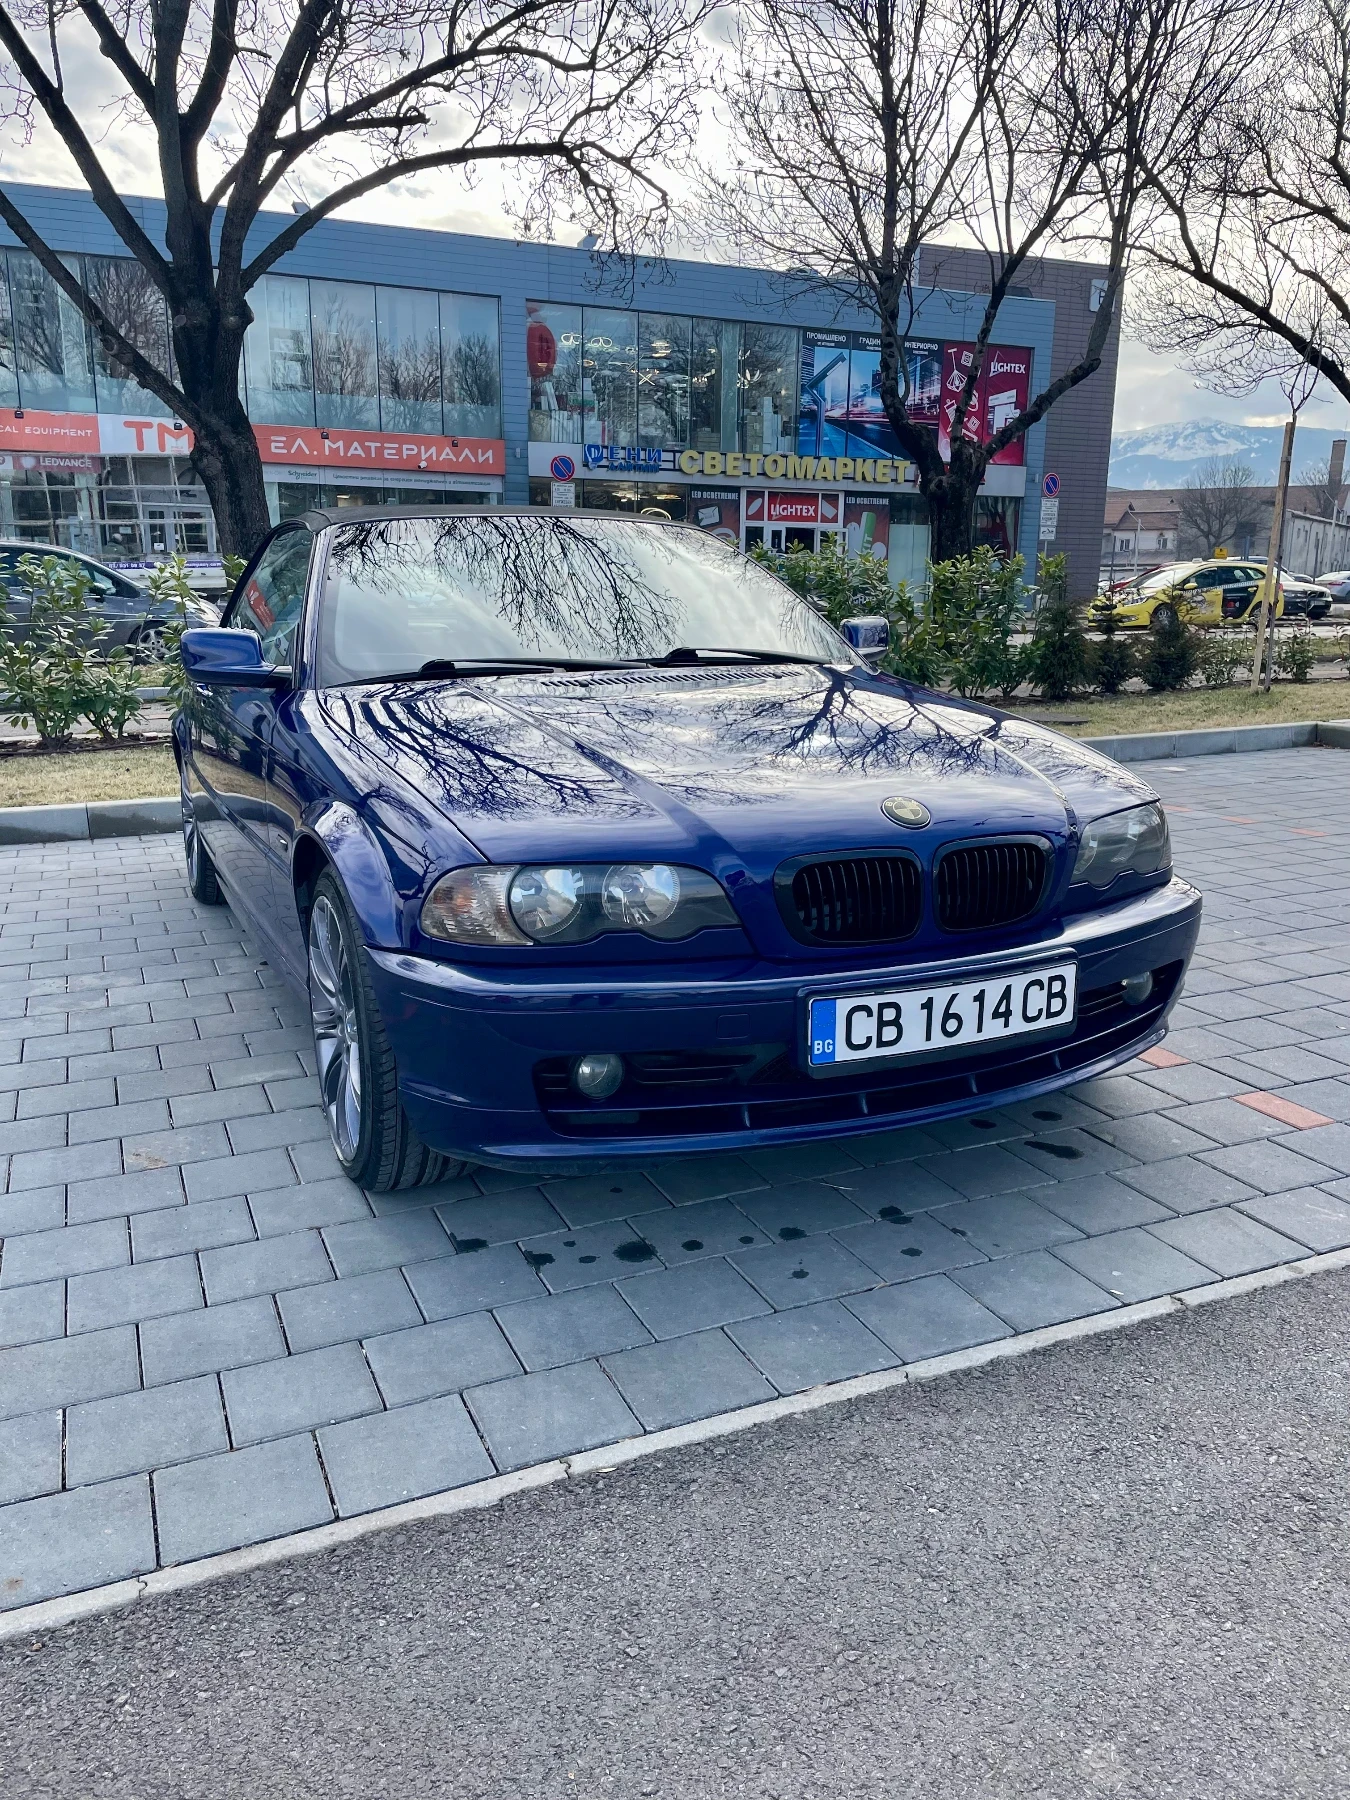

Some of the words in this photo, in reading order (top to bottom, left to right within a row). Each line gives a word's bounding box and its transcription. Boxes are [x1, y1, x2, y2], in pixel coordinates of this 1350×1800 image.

[806, 331, 847, 342] ПРОМИШЛЕНО
[859, 337, 881, 345] ГРАДИН
[24, 426, 93, 437] EQUIPMENT
[40, 456, 92, 468] LEDVANCE
[679, 450, 911, 484] СВЕТОМАРКЕТ
[287, 470, 318, 480] Schneider
[691, 490, 702, 499] LED
[770, 503, 816, 517] LIGHTEX
[920, 984, 1013, 1042] 1614
[814, 1039, 834, 1055] BG
